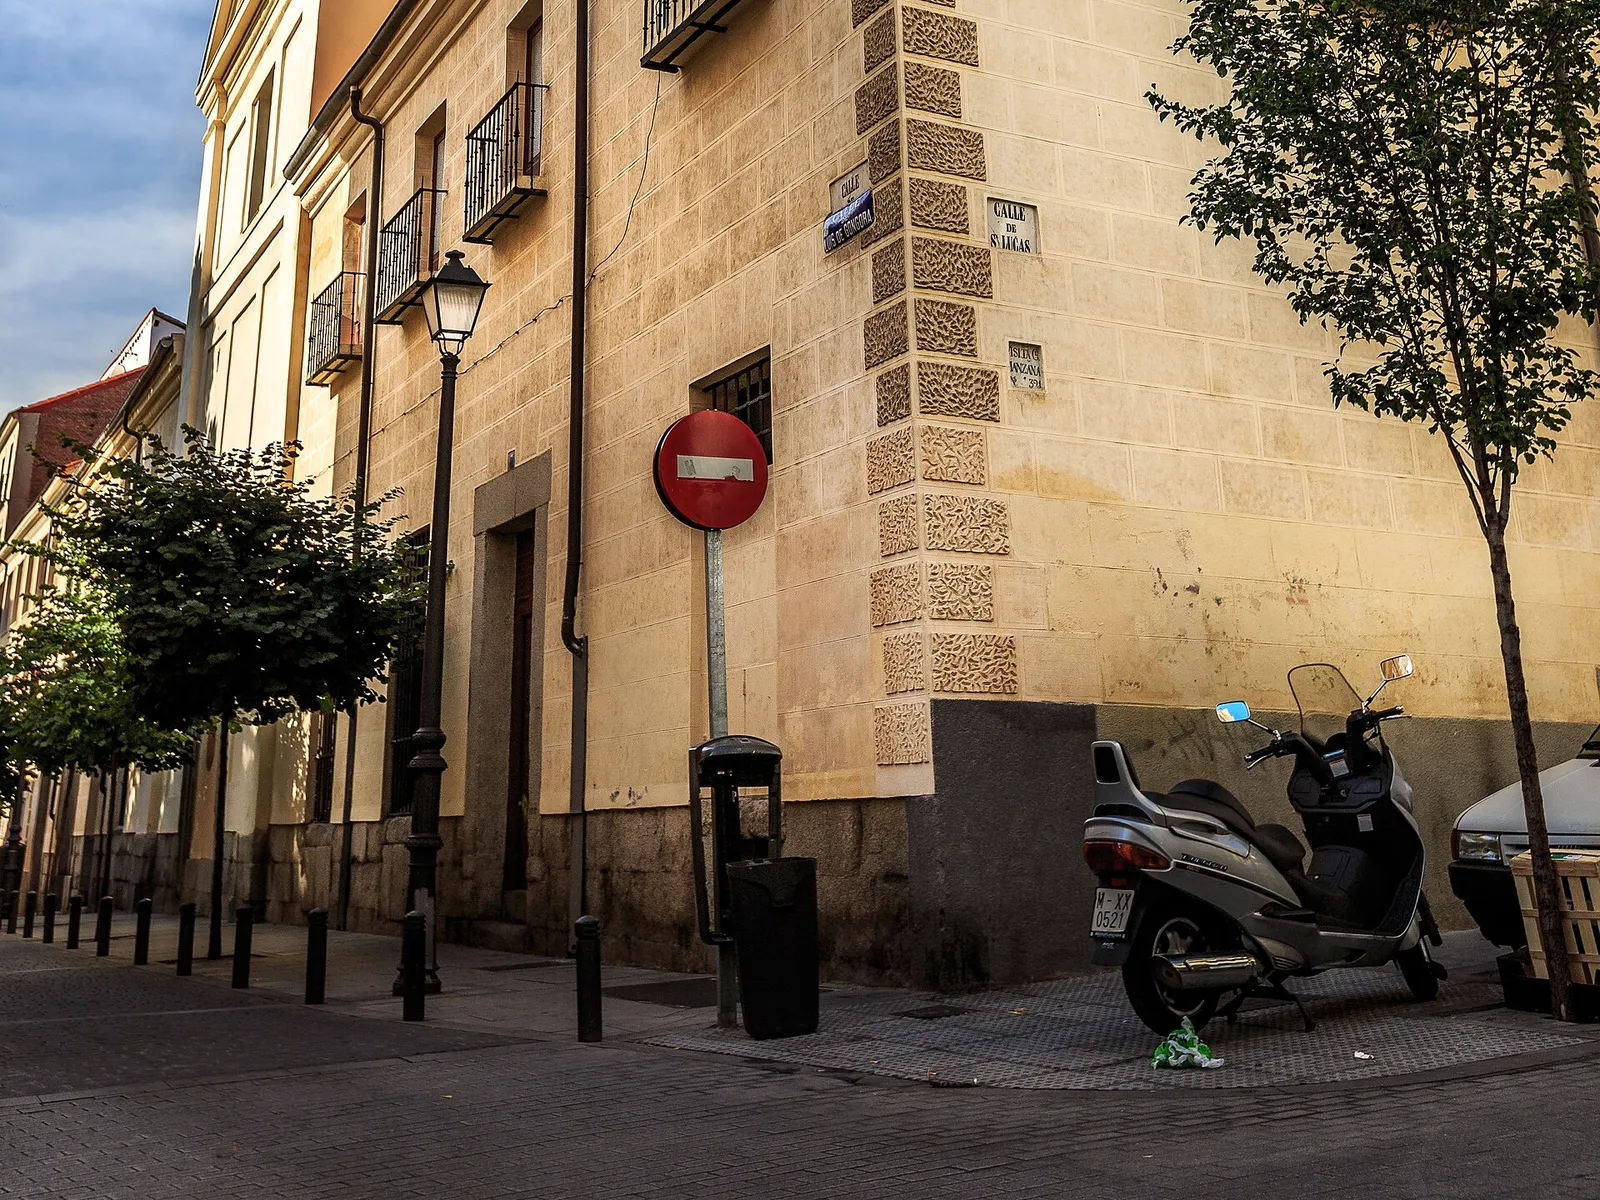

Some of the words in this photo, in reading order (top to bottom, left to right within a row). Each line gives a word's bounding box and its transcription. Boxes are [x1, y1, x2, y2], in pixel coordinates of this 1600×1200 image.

[841, 174, 860, 198] CALLE
[994, 201, 1025, 221] CALLE
[835, 227, 845, 244] DE
[1006, 223, 1016, 233] DE
[1001, 235, 1031, 253] LUCAS
[1096, 910, 1125, 929] 0521
